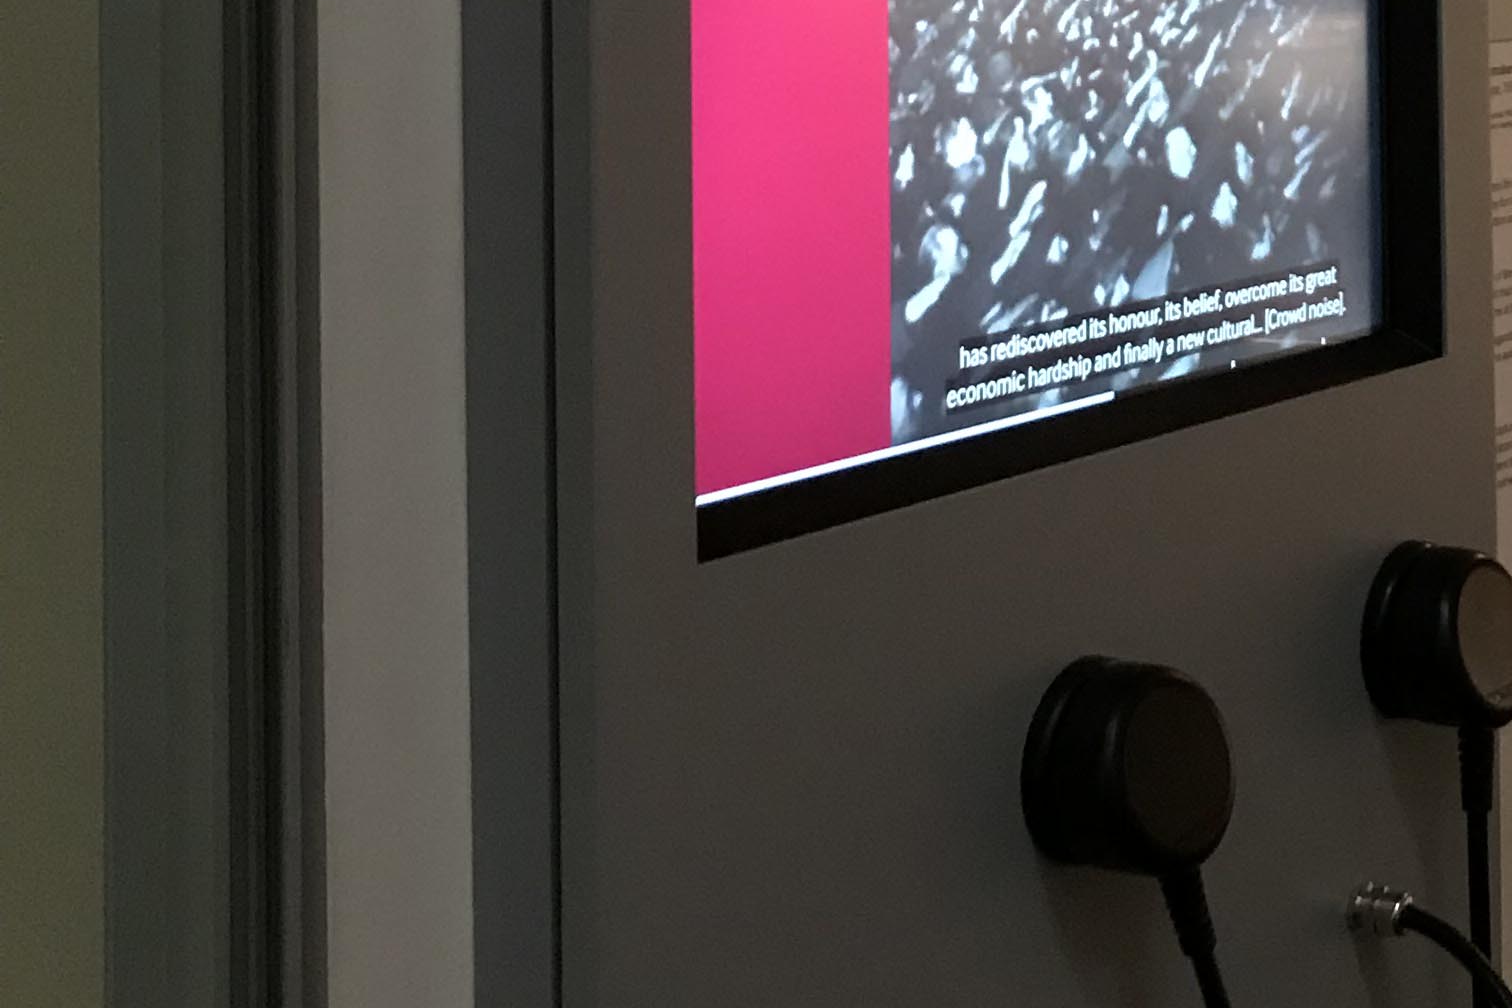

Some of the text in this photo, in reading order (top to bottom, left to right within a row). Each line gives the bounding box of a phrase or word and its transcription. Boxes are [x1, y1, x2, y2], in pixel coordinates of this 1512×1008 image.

[946, 370, 1026, 409] economic
[1027, 354, 1092, 389] hardship
[1094, 345, 1121, 373] and
[1123, 337, 1165, 365] finally
[1166, 337, 1175, 355] a
[1176, 330, 1206, 353] new
[1264, 302, 1307, 335] [Crowd
[959, 265, 1338, 370] has rediscovered its honour, its belief, overcome its great
